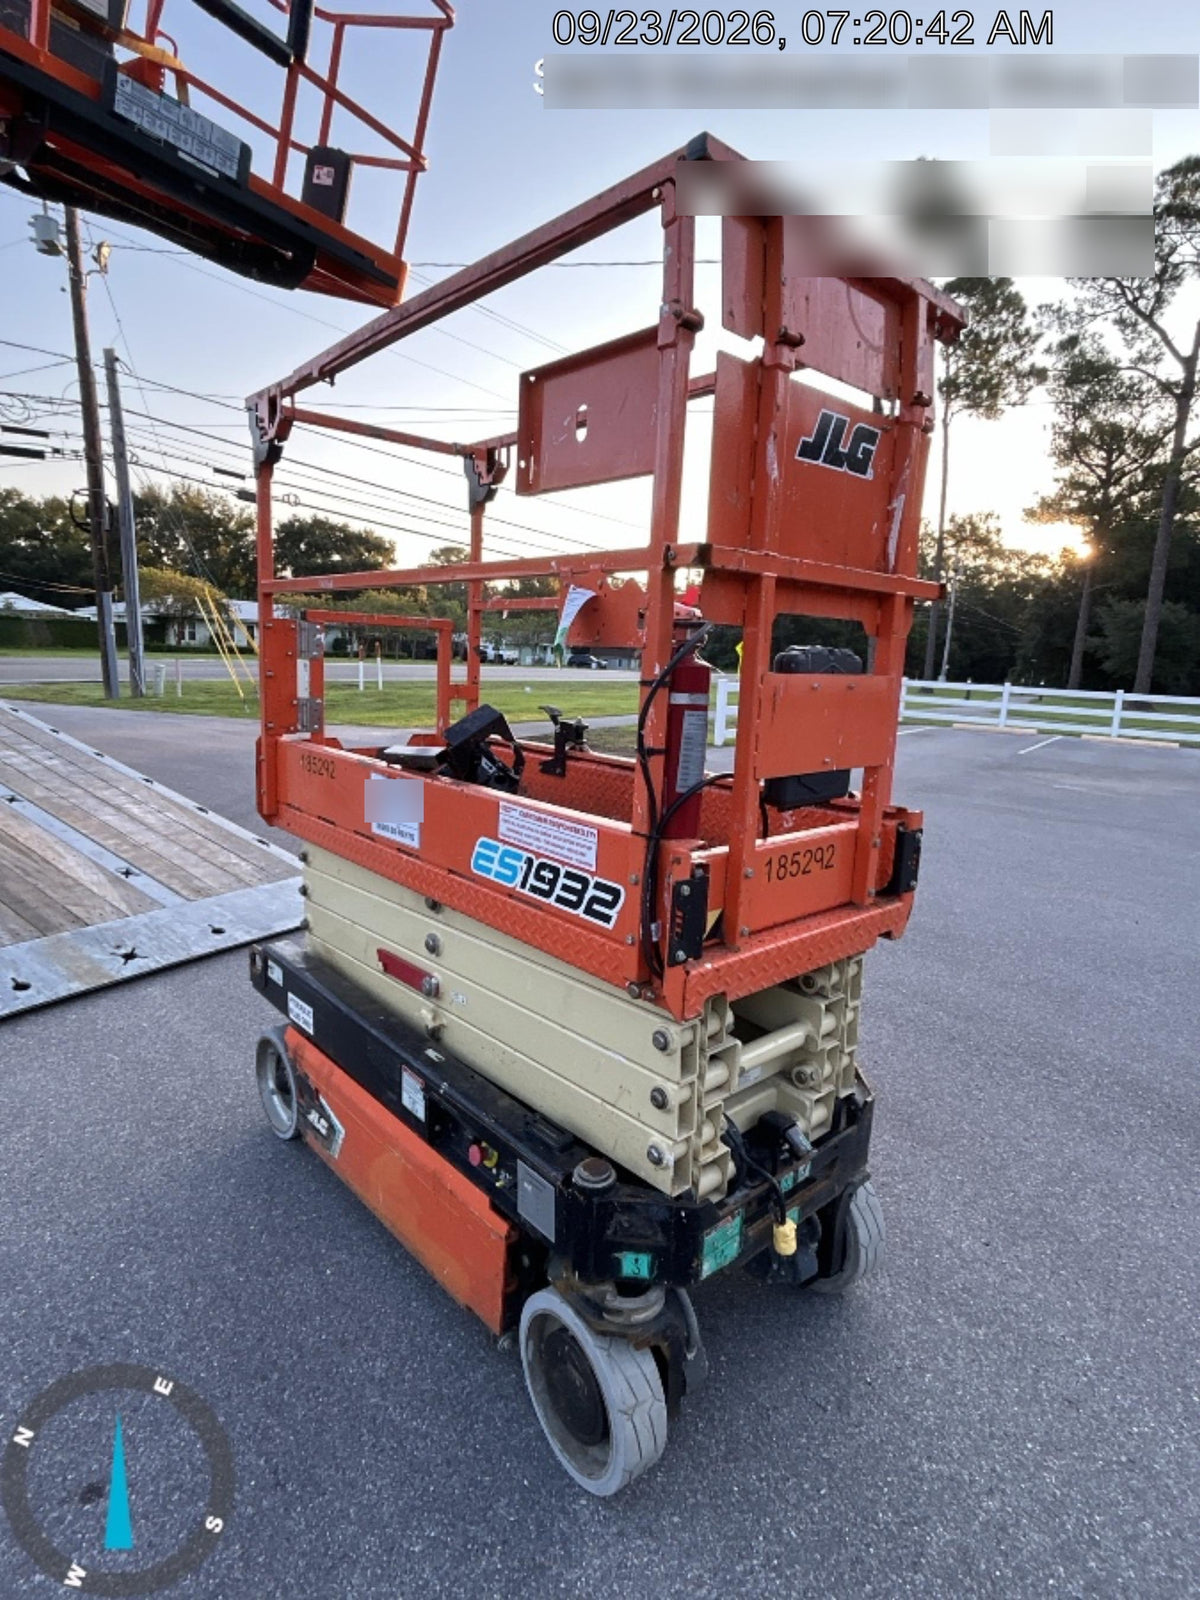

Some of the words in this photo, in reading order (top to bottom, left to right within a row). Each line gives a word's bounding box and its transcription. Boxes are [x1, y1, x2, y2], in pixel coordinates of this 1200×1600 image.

[795, 409, 881, 479] JLG
[300, 754, 336, 779] 185292
[472, 839, 624, 927] ES1932
[765, 844, 835, 883] 185292
